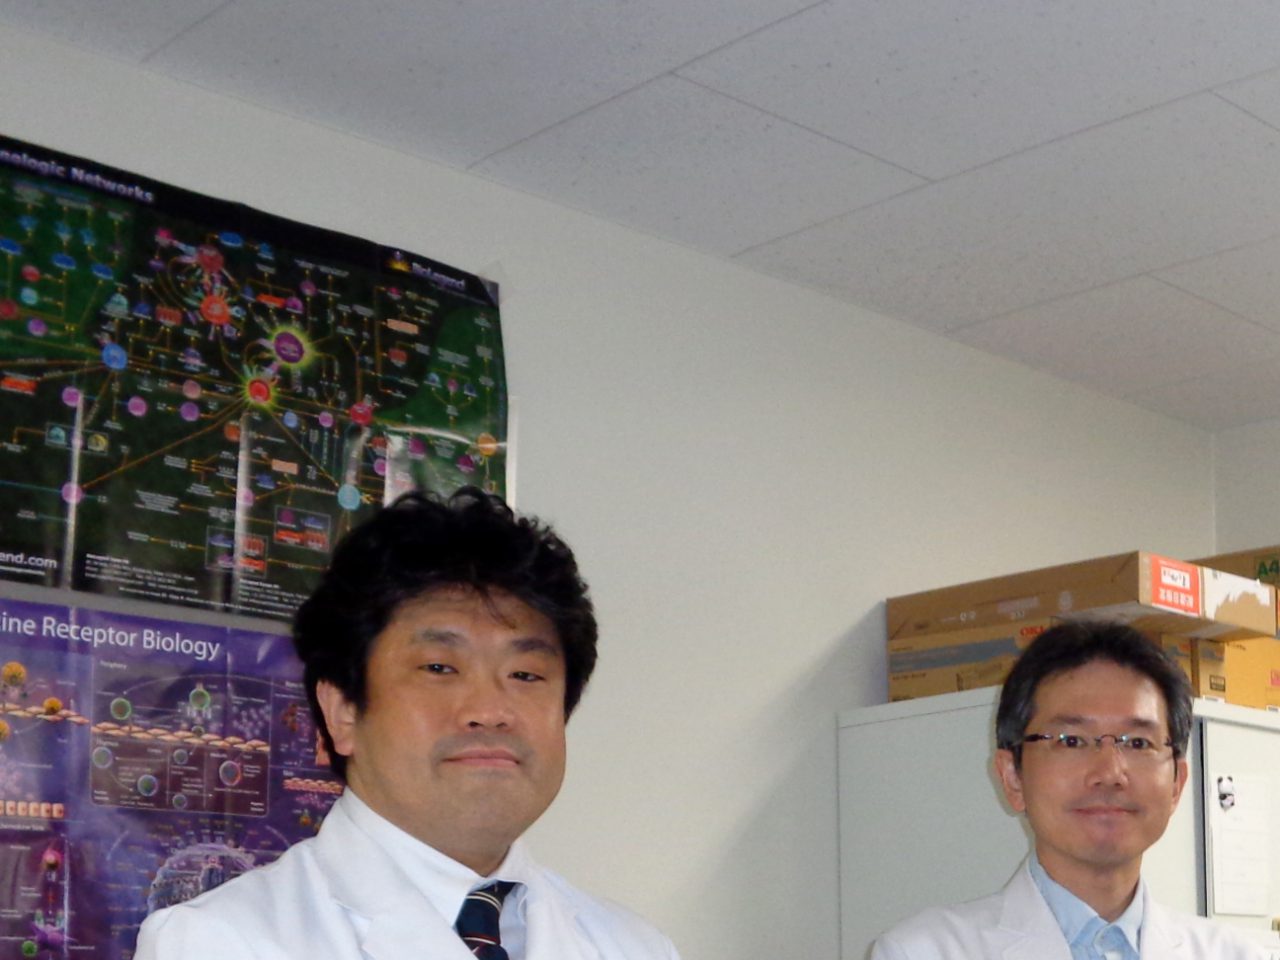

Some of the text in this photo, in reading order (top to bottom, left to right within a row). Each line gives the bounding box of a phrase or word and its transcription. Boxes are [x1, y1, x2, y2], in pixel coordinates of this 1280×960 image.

[69, 167, 155, 203] Networks
[1257, 559, 1280, 577] A4
[0, 611, 220, 661] ine Receptor Biology
